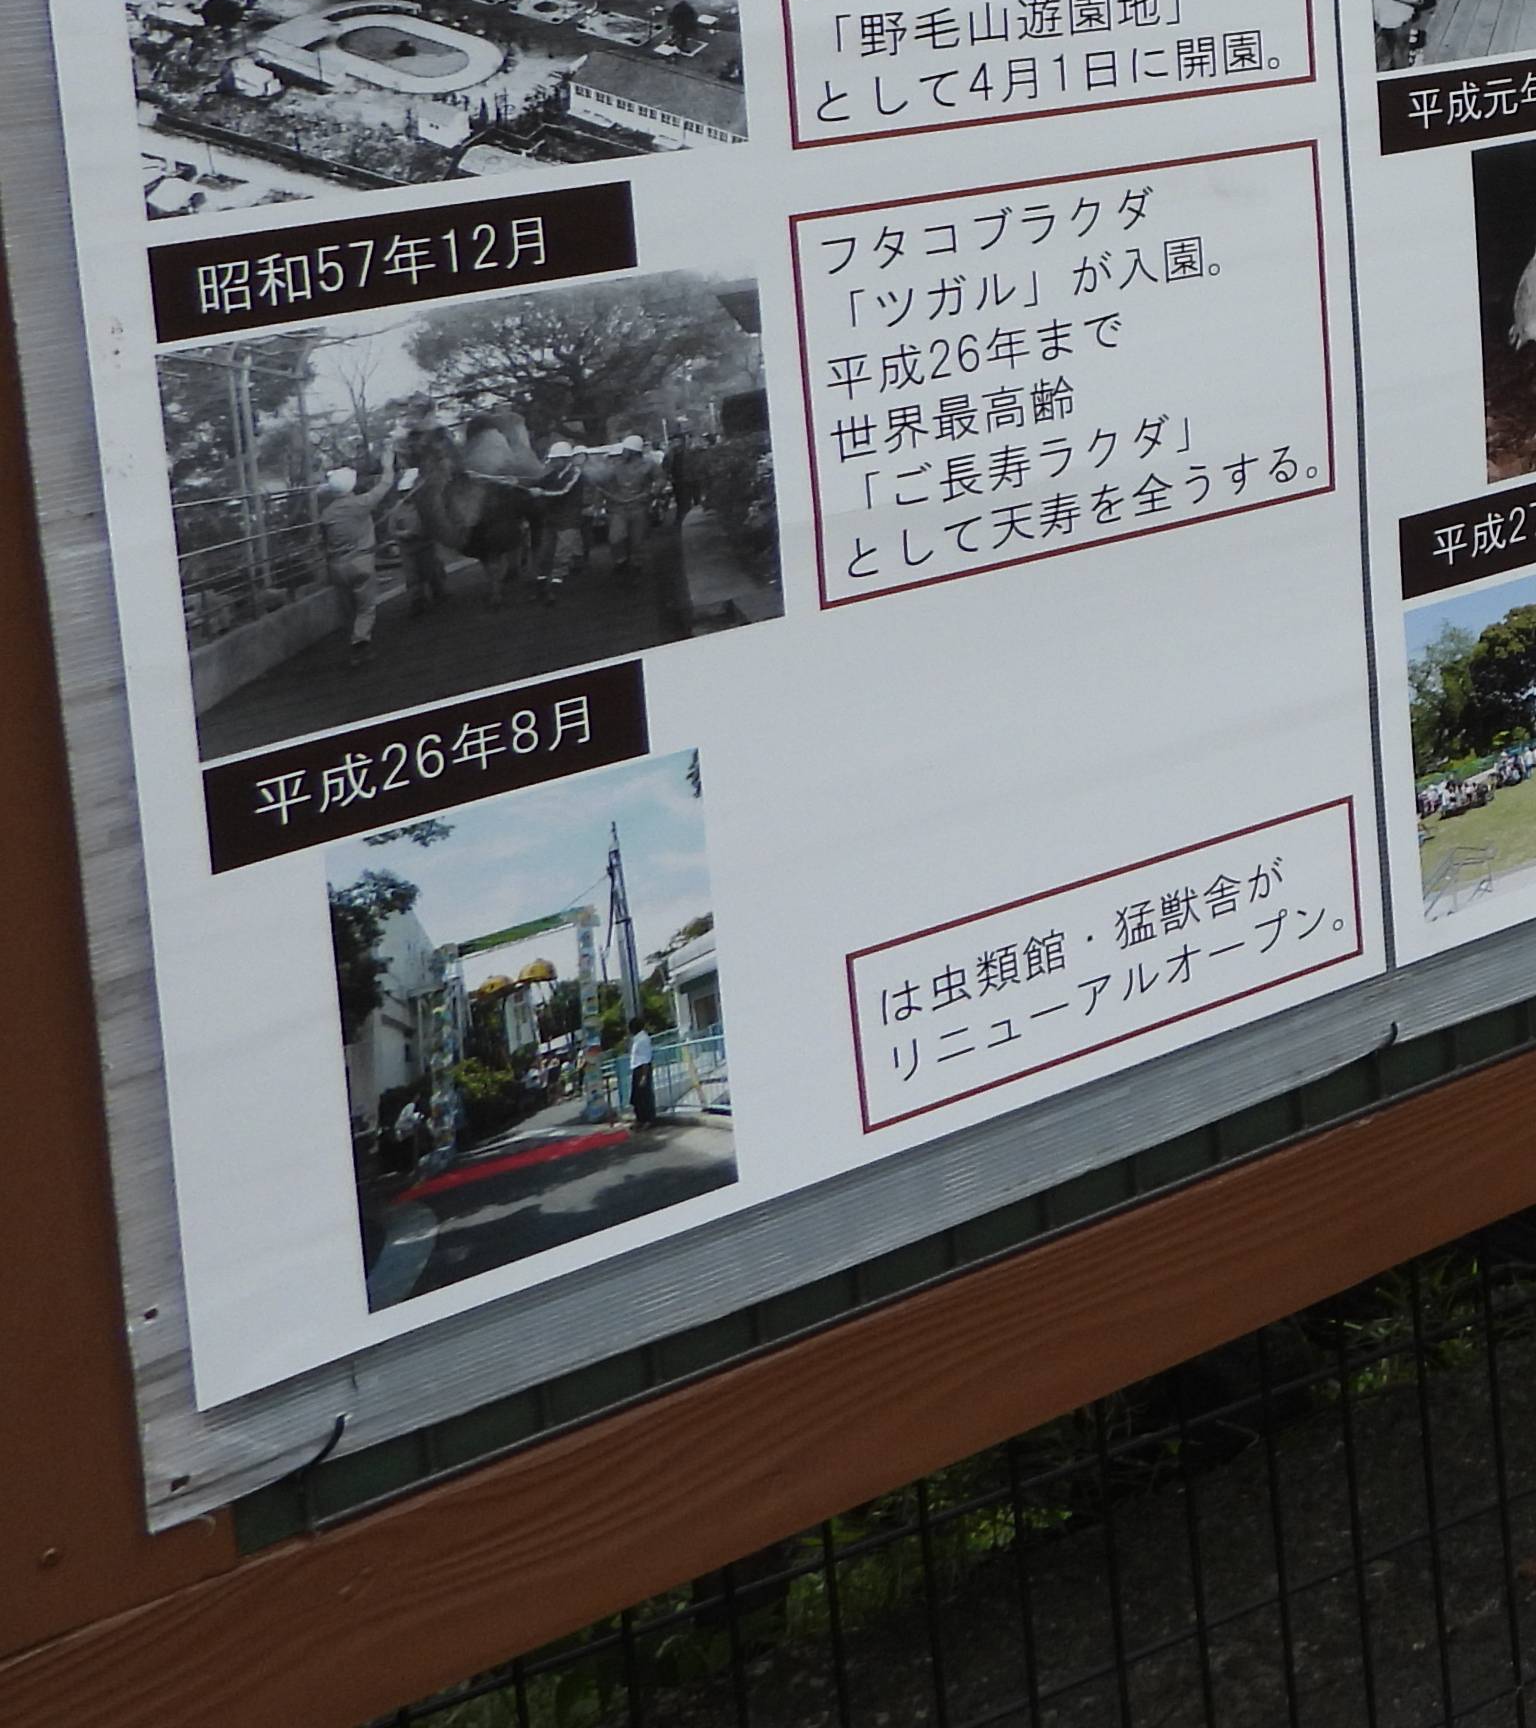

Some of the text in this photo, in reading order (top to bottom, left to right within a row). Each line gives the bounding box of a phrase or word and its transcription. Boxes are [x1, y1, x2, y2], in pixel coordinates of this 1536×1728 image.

[816, 29, 1283, 123] として4月1日に開園。
[197, 216, 548, 315] 昭和57年12月
[820, 186, 1157, 277] フタコブラクダ
[845, 236, 1223, 331] 「ツガル」が入園。
[827, 310, 1122, 402] 平成26年まで
[831, 377, 1076, 465] 世界最高齢
[861, 415, 1194, 513] 「ご長寿ラクダ」
[846, 444, 1319, 581] として天寿を全うする。
[254, 695, 593, 825] 平成26年8月
[879, 859, 1286, 1027] は虫類館・猛獣舎が
[890, 904, 1347, 1083] リニューアルオープン。
